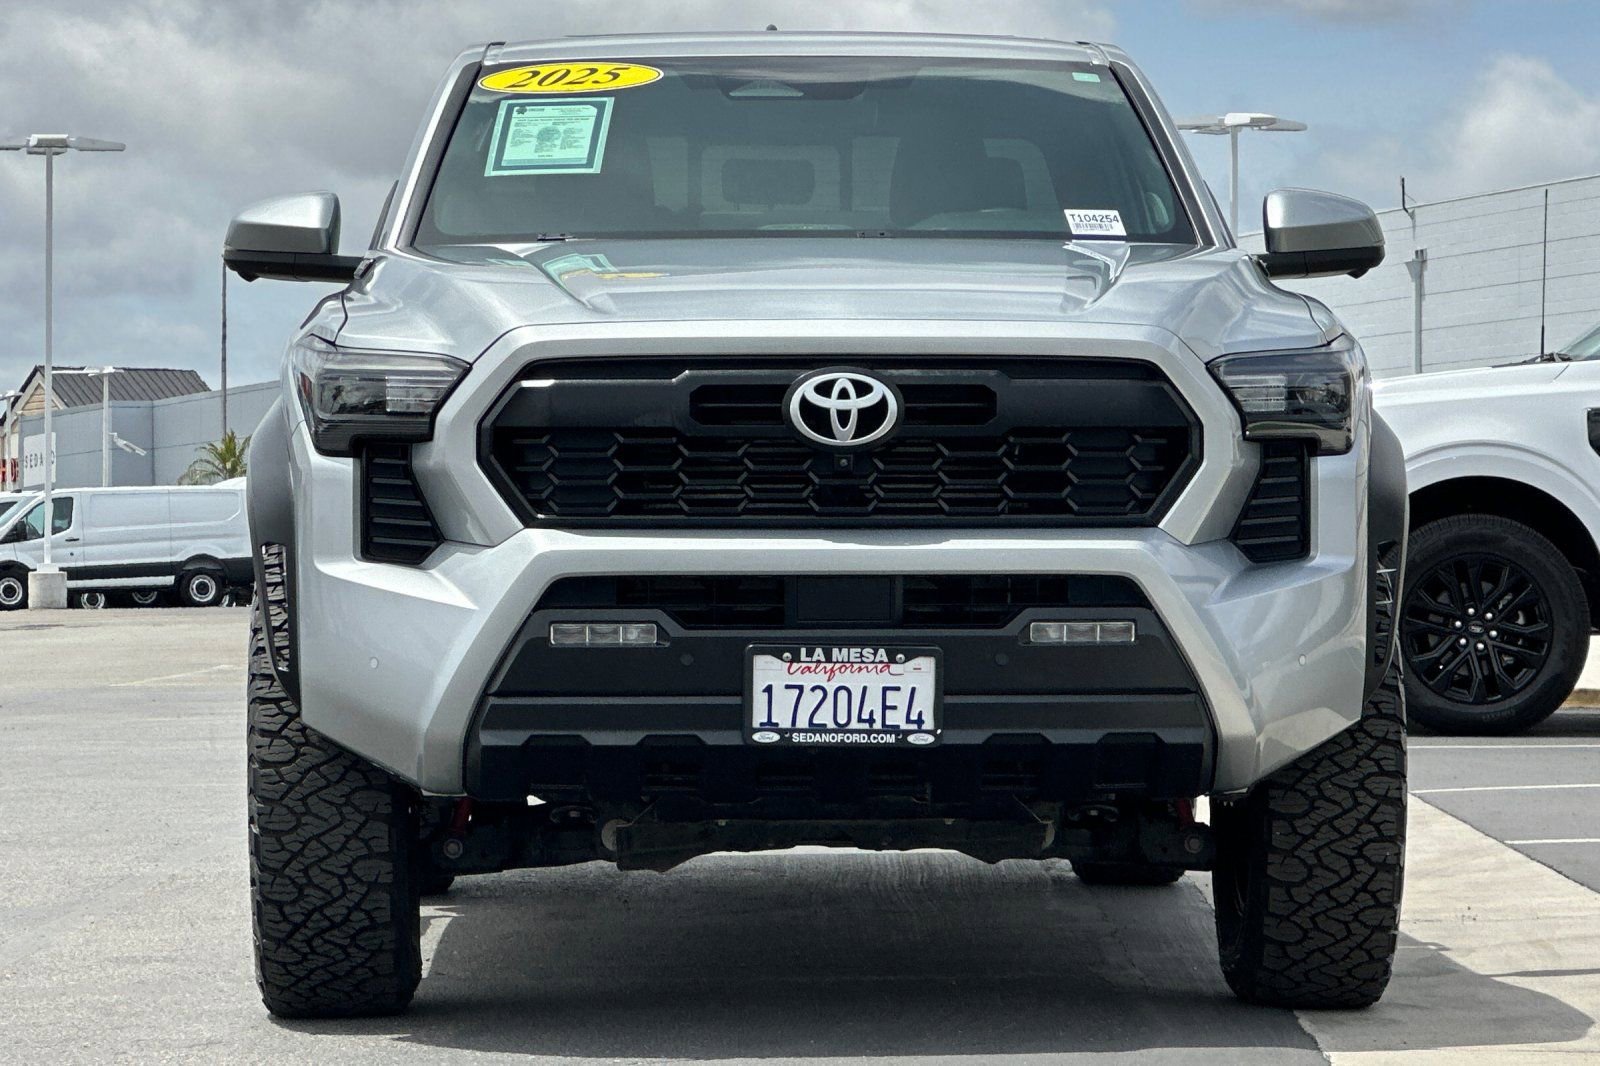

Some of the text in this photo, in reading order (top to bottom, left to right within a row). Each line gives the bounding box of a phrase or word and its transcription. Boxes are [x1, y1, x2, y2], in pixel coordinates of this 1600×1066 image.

[504, 66, 630, 89] 2025
[1069, 213, 1119, 223] T104254
[800, 647, 889, 663] LA MESA
[787, 660, 904, 682] California
[759, 684, 925, 730] 17204E4
[791, 732, 896, 744] SEDANOFORD.COM
